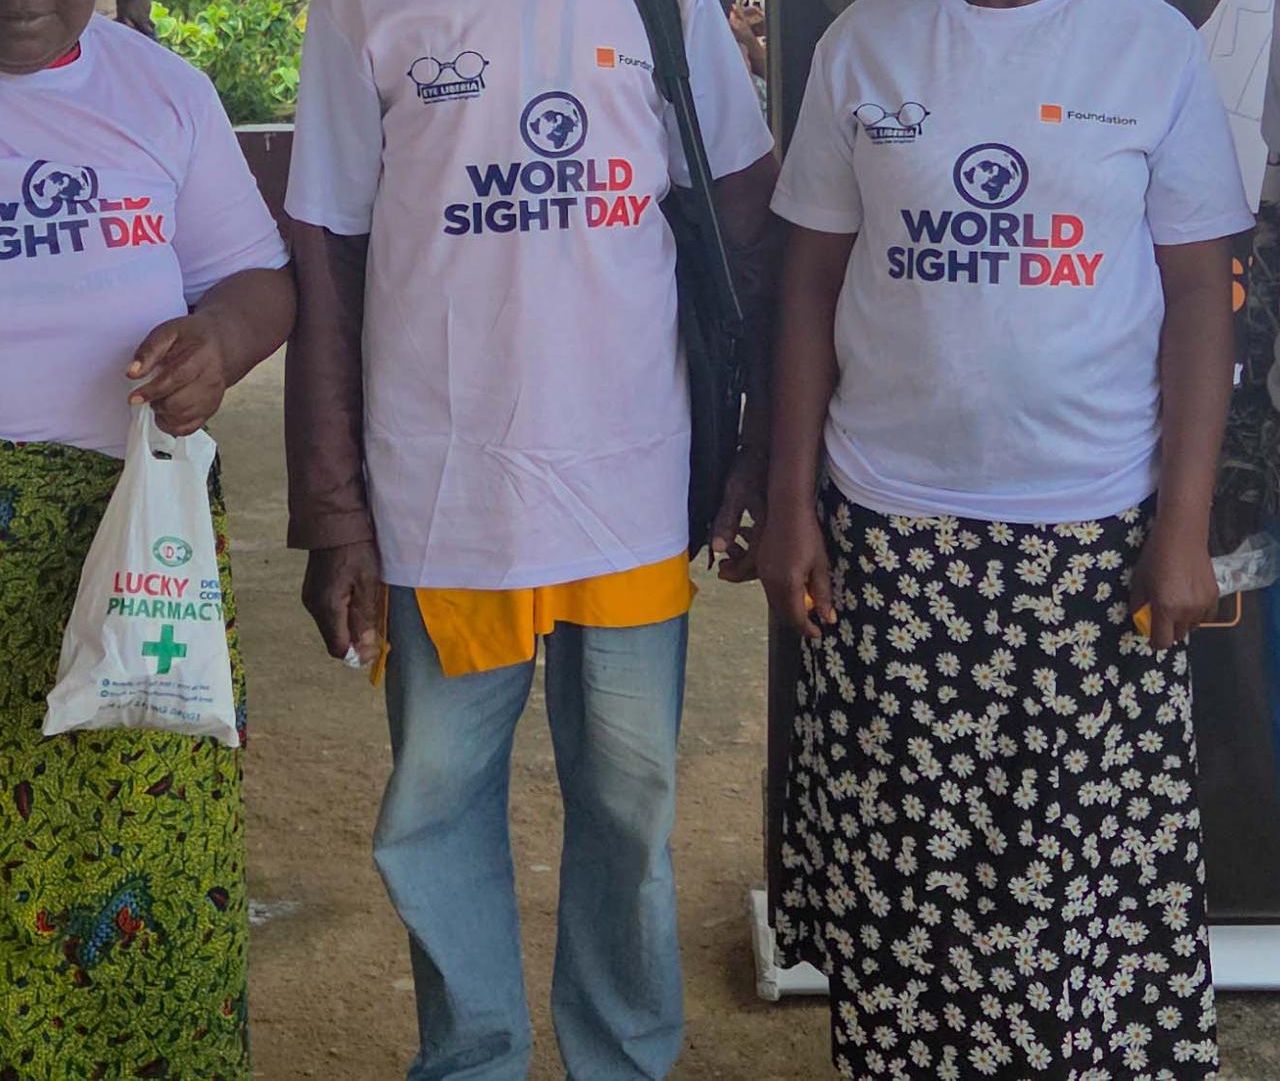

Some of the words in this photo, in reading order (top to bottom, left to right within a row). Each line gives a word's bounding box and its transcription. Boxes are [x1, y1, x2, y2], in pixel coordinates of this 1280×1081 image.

[1067, 110, 1137, 126] Foundation
[465, 158, 634, 197] WORLD
[99, 214, 168, 249] DAY
[443, 196, 578, 236] SIGHT
[585, 195, 651, 229] DAY
[901, 208, 1085, 249] WORLD
[887, 246, 1010, 285] SIGHT
[1019, 252, 1104, 287] DAY
[113, 571, 190, 599] LUCKY
[107, 597, 224, 621] PHARMACY
